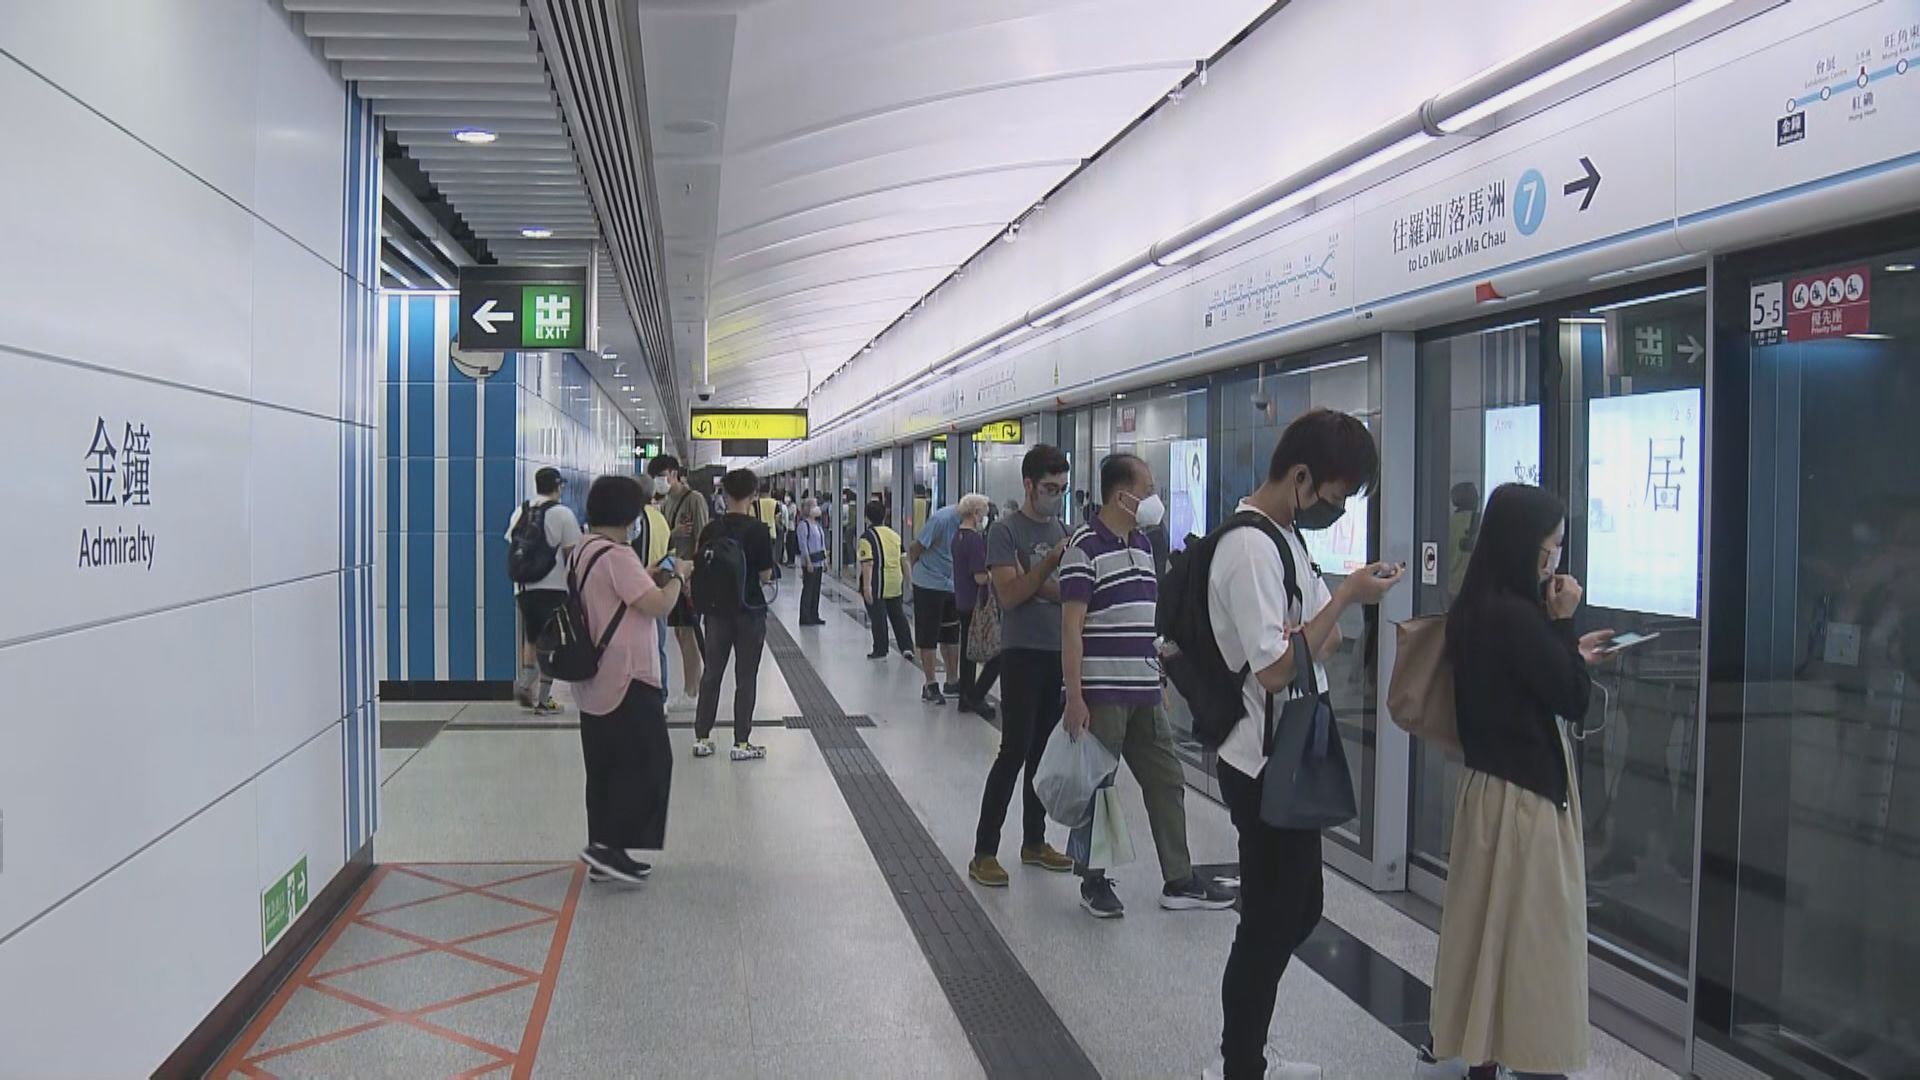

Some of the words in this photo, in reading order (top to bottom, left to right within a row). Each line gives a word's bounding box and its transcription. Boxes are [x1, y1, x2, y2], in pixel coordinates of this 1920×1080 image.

[1393, 178, 1505, 255] 往羅湖/落馬洲
[1523, 181, 1538, 225] 7
[1409, 249, 1417, 272] to
[1419, 246, 1428, 270] Lo
[1430, 238, 1463, 266] Wu/Lok
[1465, 230, 1479, 255] Ma
[1481, 225, 1506, 250] Chau
[1753, 292, 1780, 325] 5-5
[535, 325, 570, 340] EXIT
[85, 415, 151, 507] 金鐘
[78, 523, 155, 572] Admiralty
